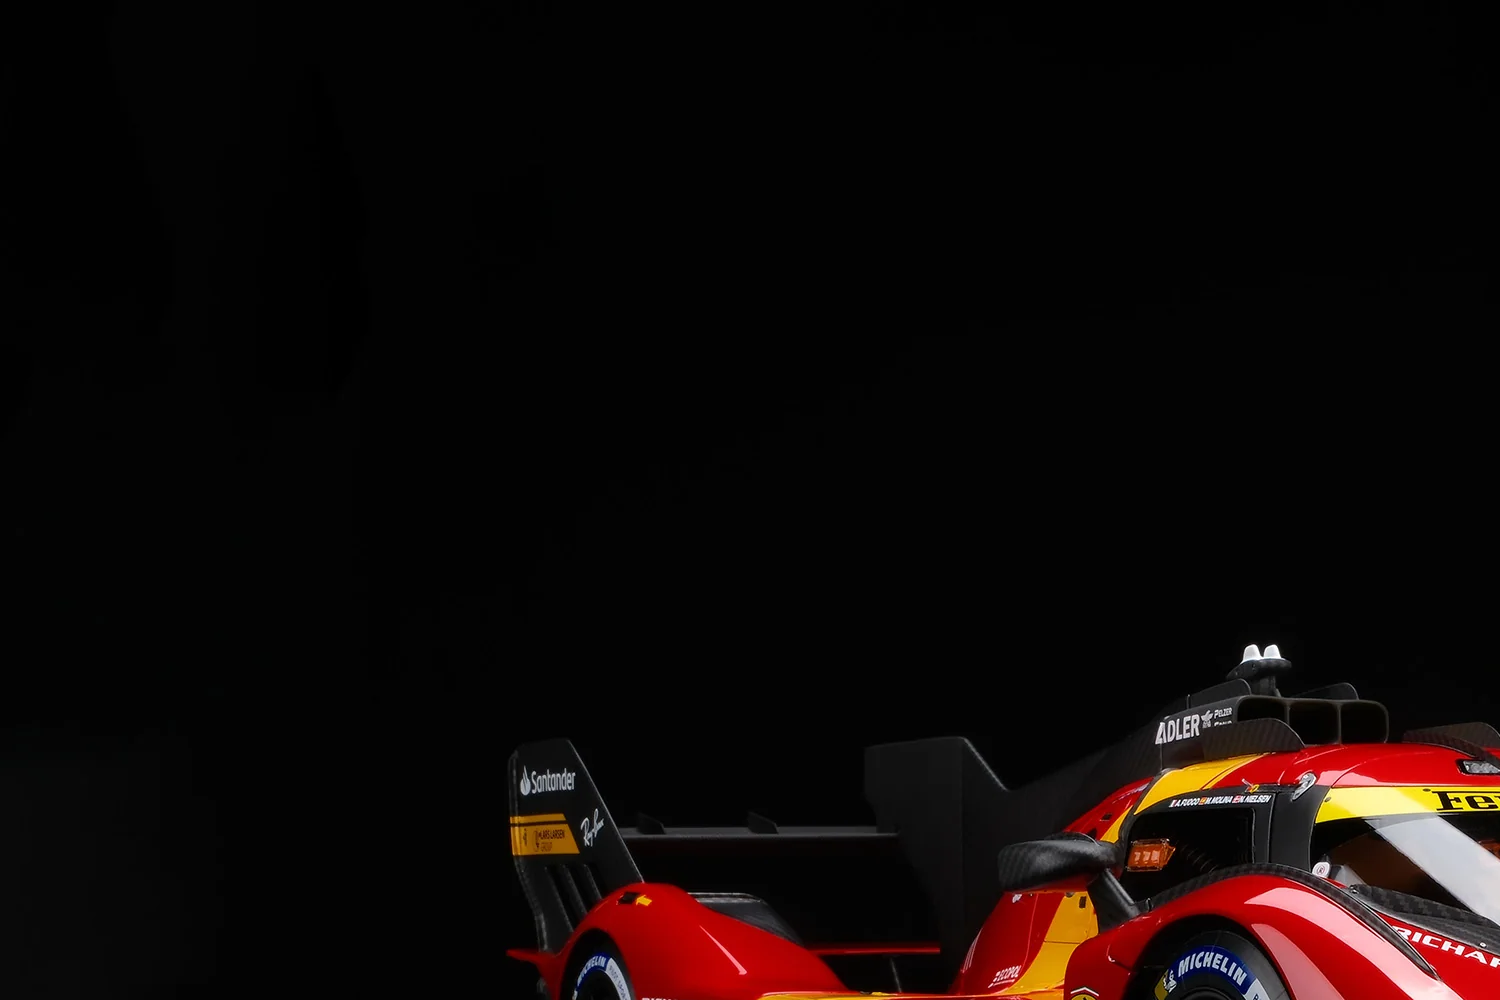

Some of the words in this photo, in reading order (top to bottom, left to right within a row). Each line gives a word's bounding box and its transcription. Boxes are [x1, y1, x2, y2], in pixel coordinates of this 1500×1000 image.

[1155, 714, 1200, 745] ADLER
[531, 767, 576, 794] Santander
[1177, 950, 1248, 986] MICHELIN
